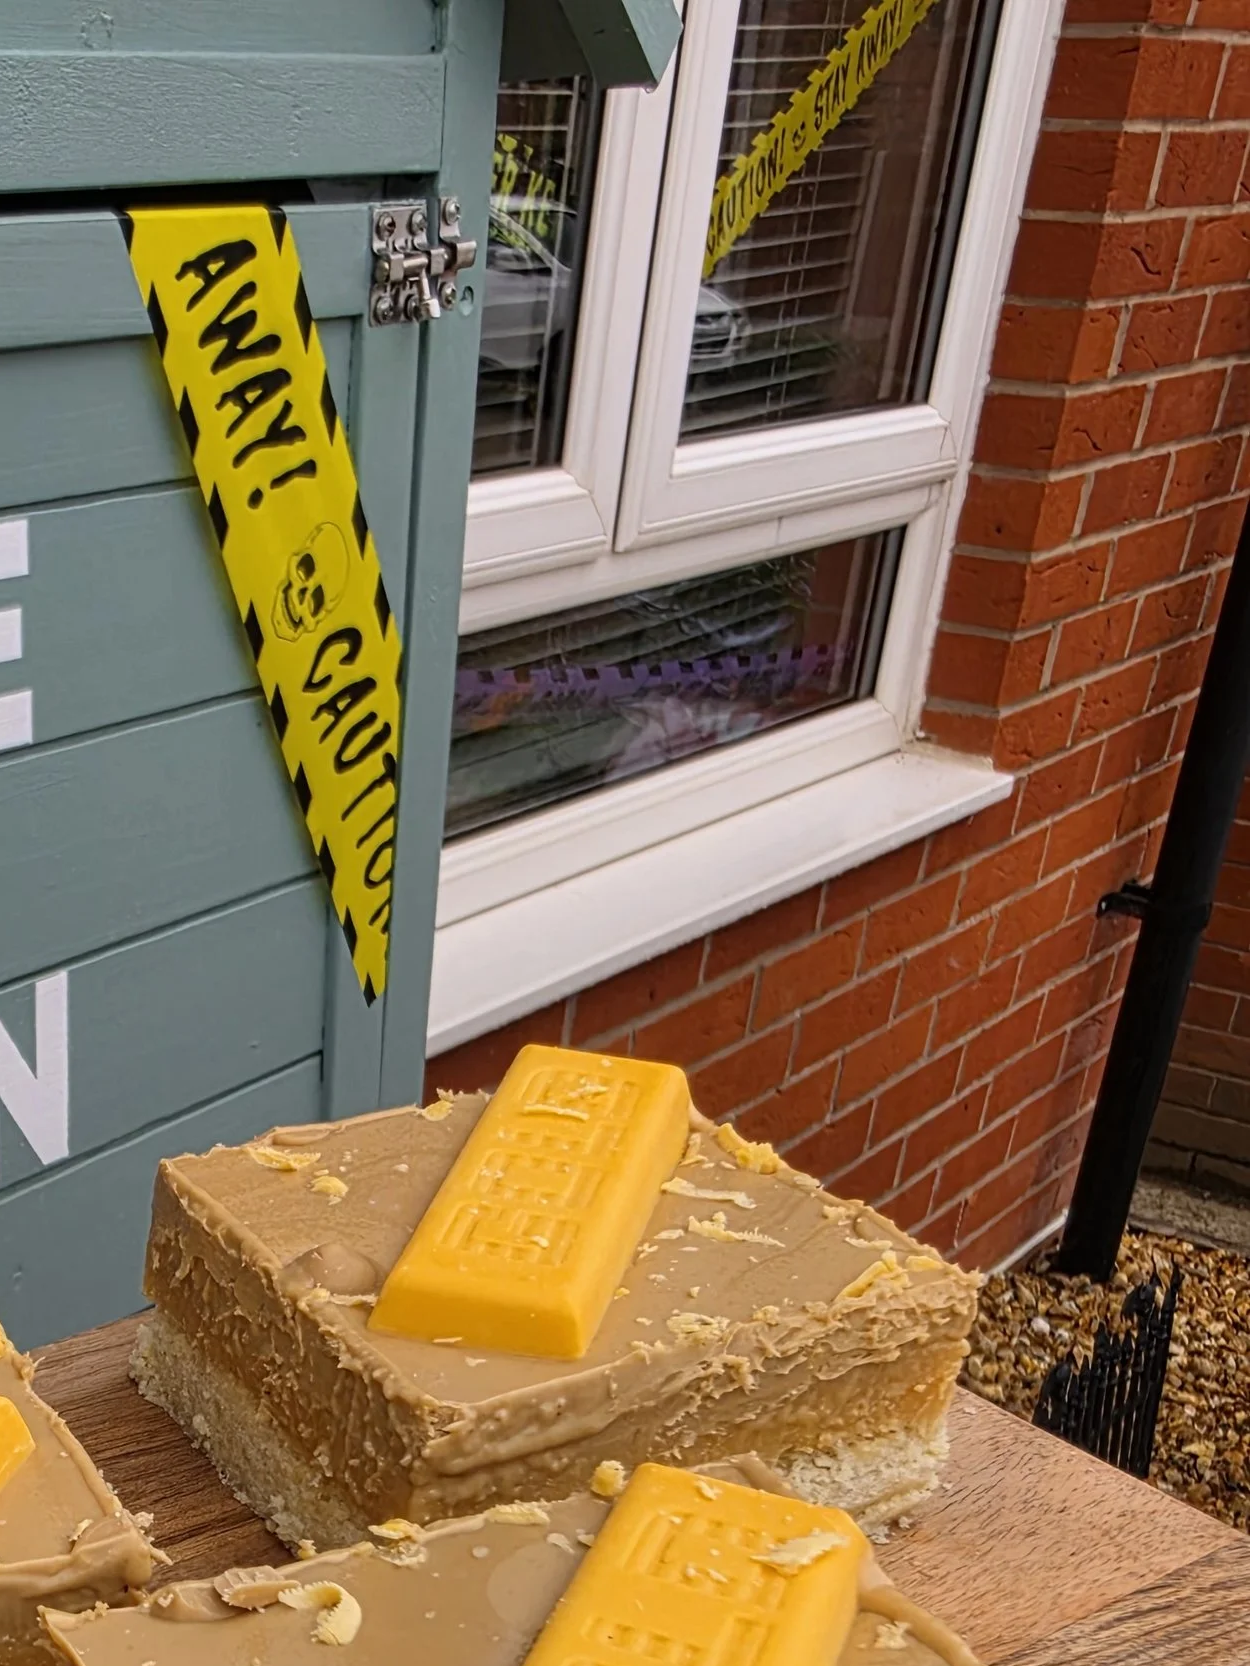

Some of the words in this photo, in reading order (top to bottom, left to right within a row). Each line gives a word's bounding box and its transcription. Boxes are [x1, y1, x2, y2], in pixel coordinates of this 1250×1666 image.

[706, 127, 786, 256] CAUTION!
[814, 52, 851, 132] STAY
[856, 0, 903, 85] AWAY!
[175, 239, 317, 510] AWAY!
